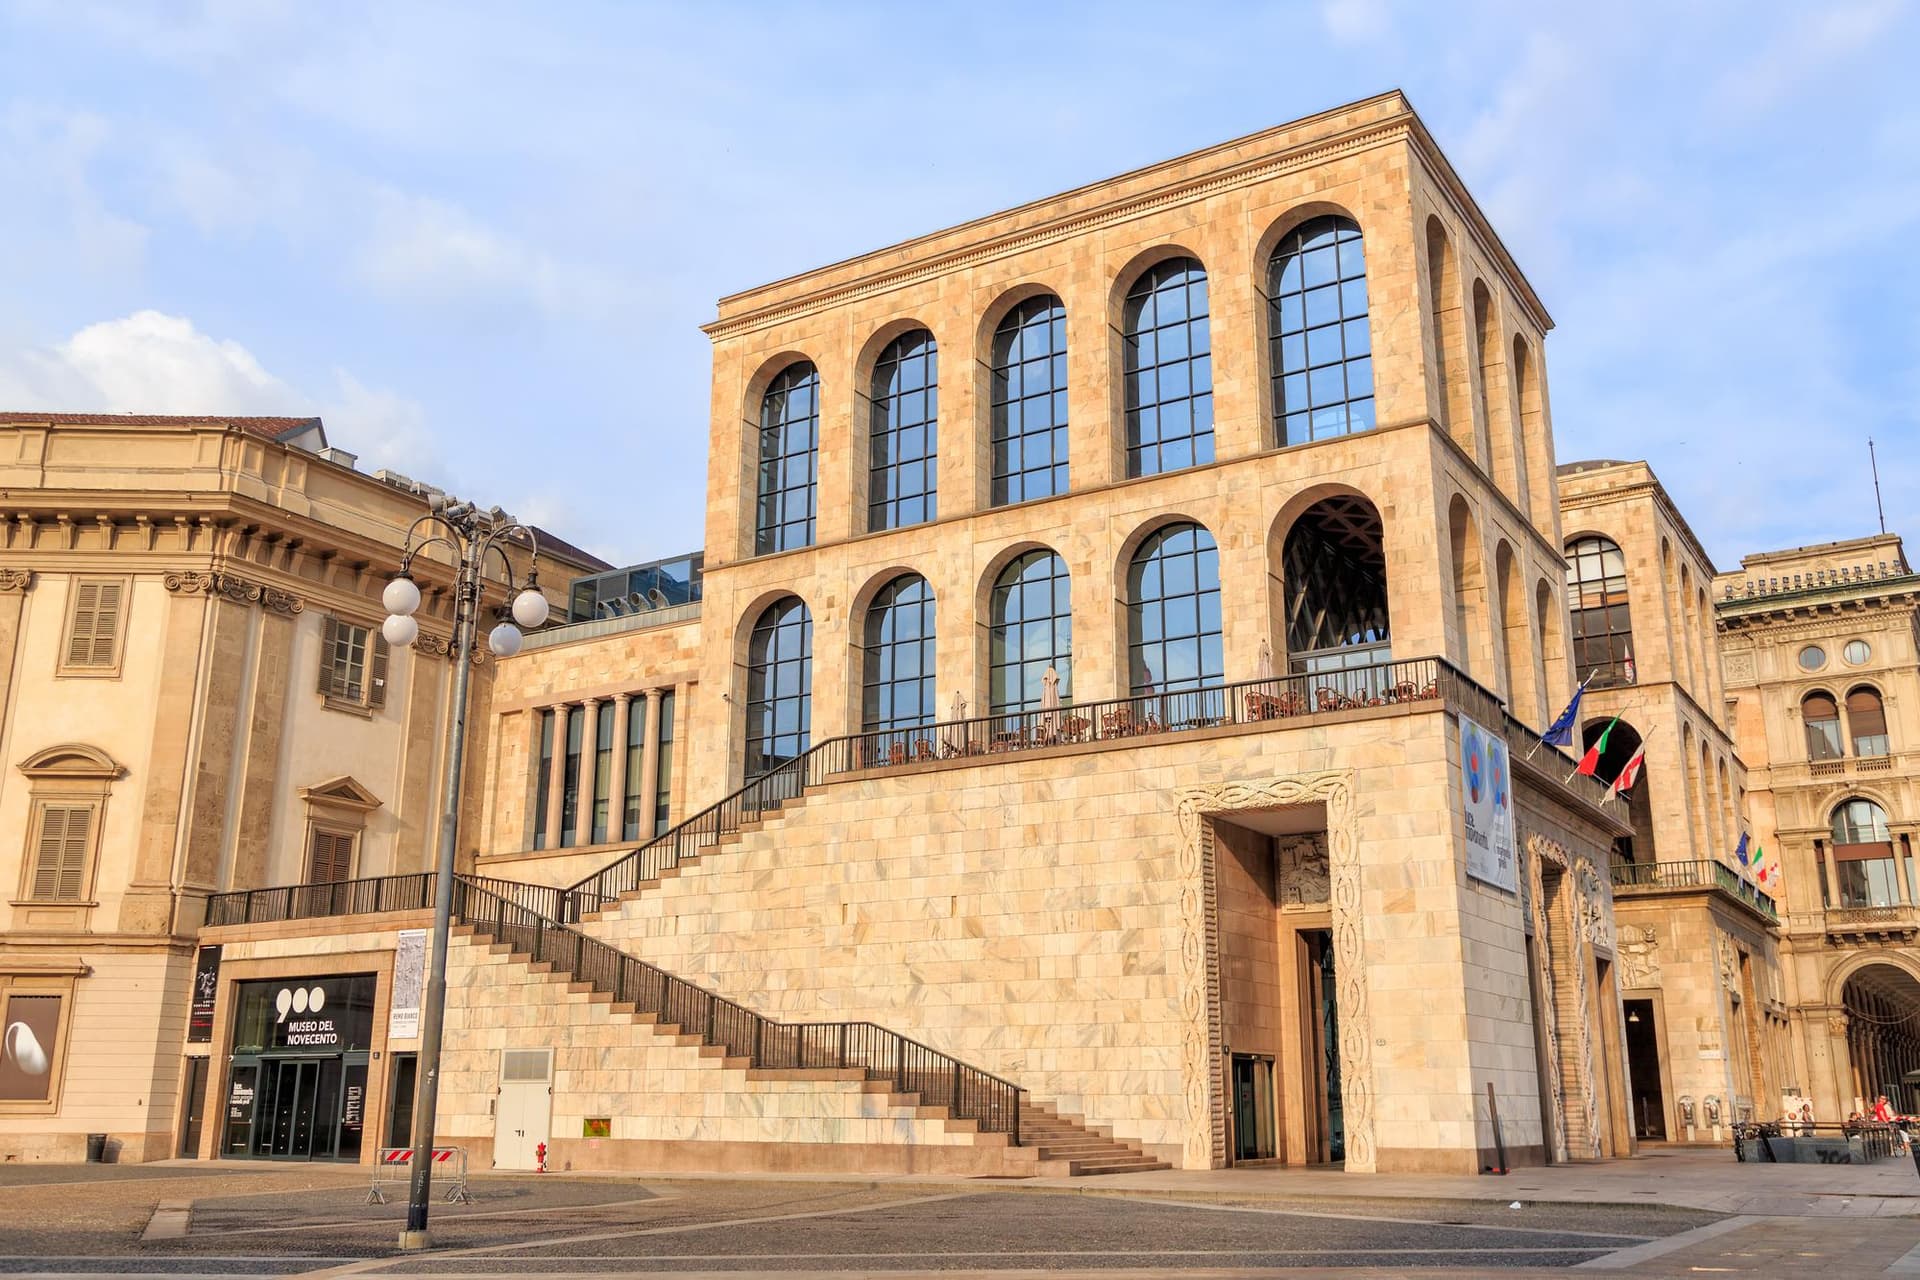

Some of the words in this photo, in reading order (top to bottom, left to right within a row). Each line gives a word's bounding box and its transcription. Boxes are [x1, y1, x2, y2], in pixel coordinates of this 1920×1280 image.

[276, 986, 325, 1023] 900
[288, 1021, 317, 1032] MUSEO
[318, 1020, 334, 1031] DEL
[287, 1033, 338, 1045] NOVECENTO
